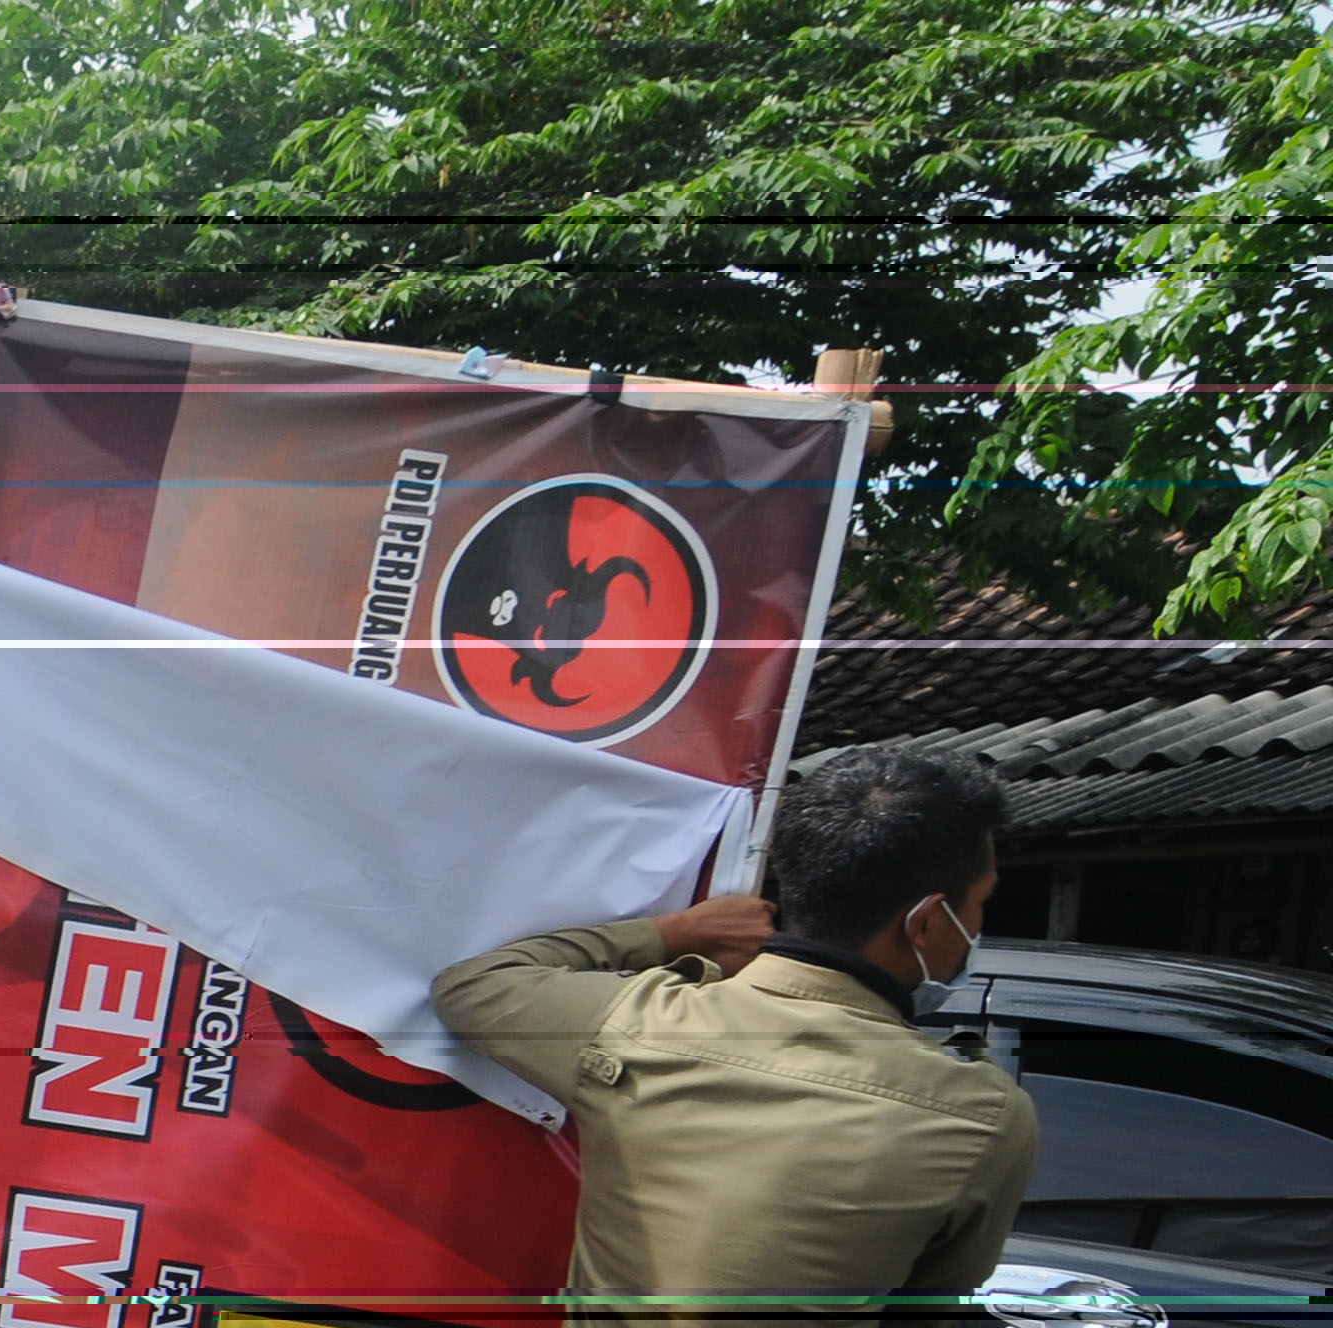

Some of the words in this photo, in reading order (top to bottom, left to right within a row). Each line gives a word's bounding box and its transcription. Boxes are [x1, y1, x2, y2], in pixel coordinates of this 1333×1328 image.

[390, 456, 442, 516] PDI
[36, 922, 173, 1130] EN
[187, 962, 242, 1108] NGAN
